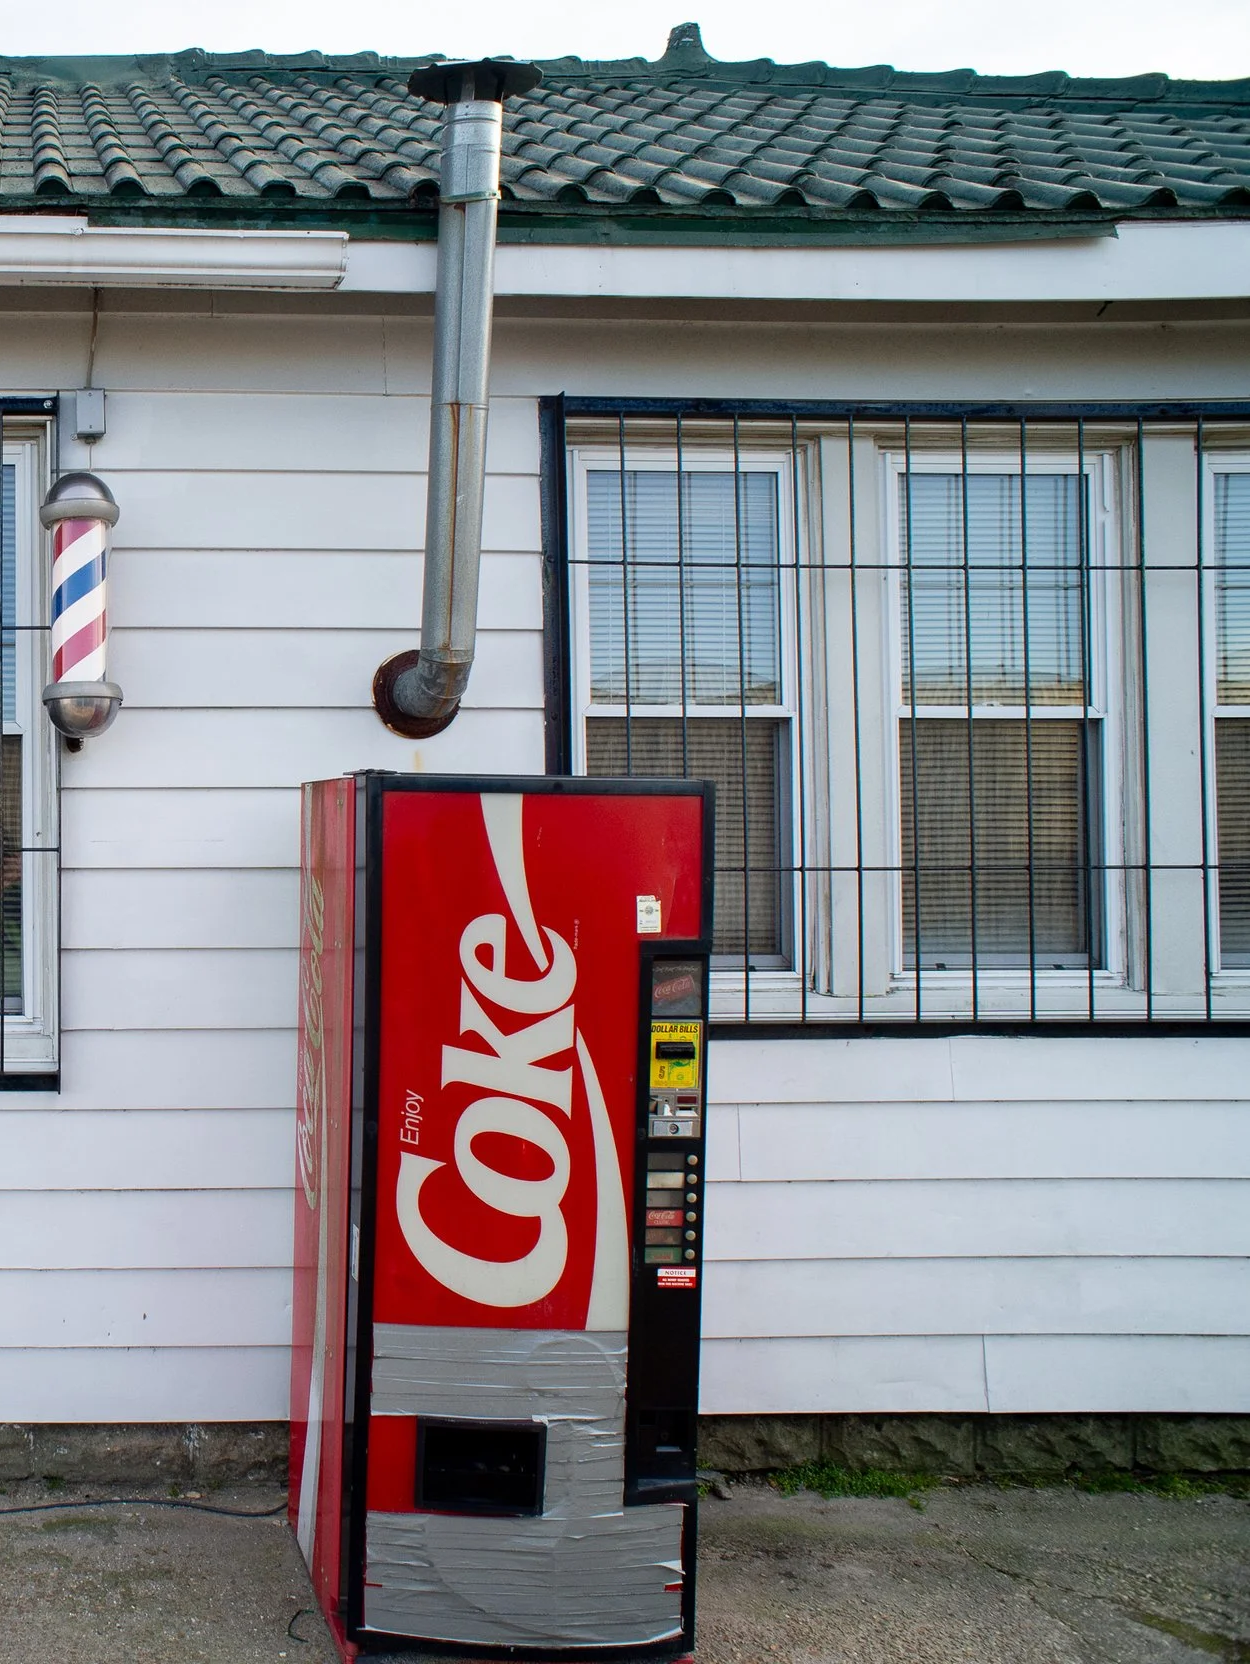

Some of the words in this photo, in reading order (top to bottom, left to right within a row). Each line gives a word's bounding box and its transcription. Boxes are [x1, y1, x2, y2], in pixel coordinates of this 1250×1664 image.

[651, 1024, 679, 1033] DOLLAR
[679, 1025, 699, 1034] BILLS
[396, 913, 578, 1308] Coke
[400, 1088, 424, 1146] Enjoy
